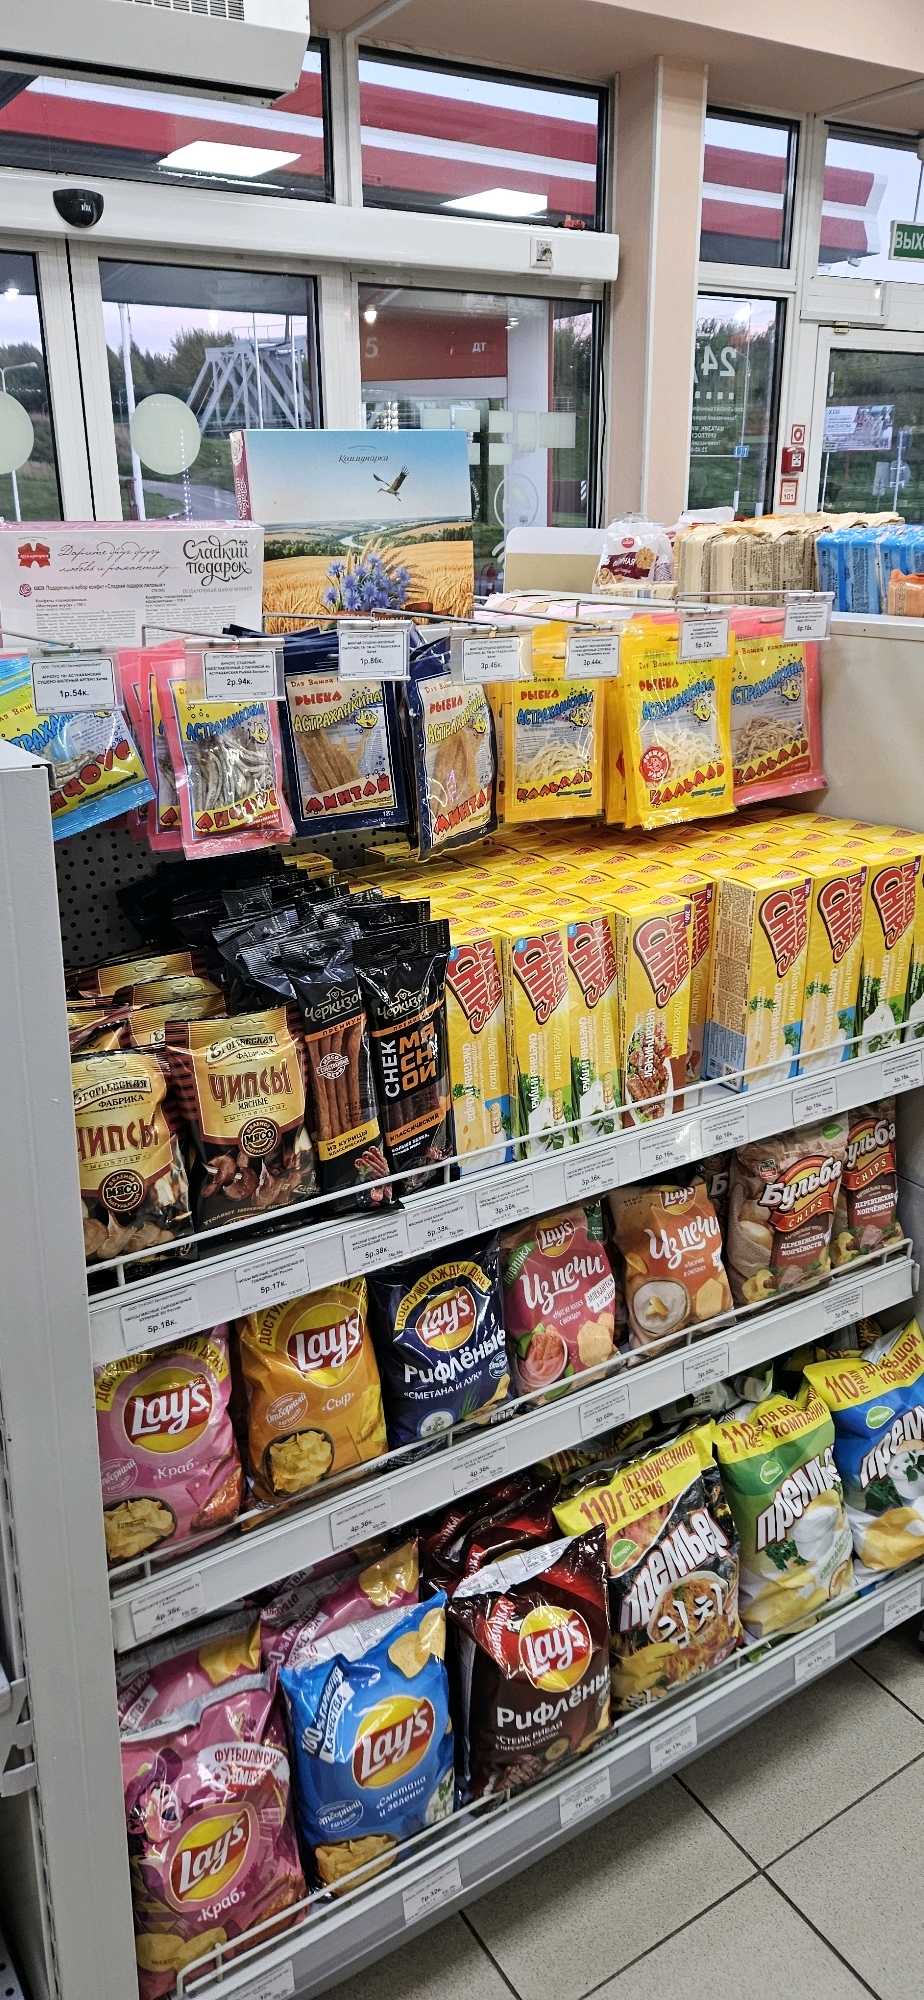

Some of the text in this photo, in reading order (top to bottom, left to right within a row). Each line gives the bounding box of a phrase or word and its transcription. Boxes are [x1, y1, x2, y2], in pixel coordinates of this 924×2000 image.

[894, 231, 924, 250] ВЫХ
[365, 337, 379, 358] 5
[472, 341, 487, 353] ДТ
[183, 535, 250, 561] Сладкий
[186, 561, 252, 587] подарок
[59, 689, 90, 699] 1р.54к.
[226, 678, 253, 687] 2р.94к.
[290, 679, 305, 688] Для
[520, 689, 560, 701] РЫБКА
[638, 677, 680, 692] РЫБКА
[293, 691, 382, 733] АСТРАХАНКИНА
[295, 690, 342, 707] РЫБКА
[429, 695, 464, 714] РЫБКА
[305, 773, 391, 815] МИНТАЙ
[516, 770, 593, 801] КАЛЬМАР
[649, 763, 726, 806] КАЛЬМАР
[821, 878, 852, 962] CHIPS
[874, 867, 906, 949] CHIPS
[762, 890, 798, 978] CHIPS
[637, 917, 677, 1008] CHIPS
[771, 982, 782, 1030] сметаны
[788, 967, 800, 1021] Мега Чипсы
[826, 968, 838, 1015] сметаны
[399, 1021, 435, 1054] МЯ
[579, 1017, 588, 1060] сметаны
[601, 1012, 612, 1064] Мега Чипсы
[643, 1008, 656, 1077] чевапчичей
[671, 1001, 683, 1059] Мега Чипсы
[381, 1040, 400, 1097] СНЕК
[463, 1043, 473, 1085] сметаны
[487, 1037, 499, 1090] Мега Чипсы
[529, 1034, 539, 1076] сметаны
[552, 1028, 562, 1080] Мега Чипсы
[208, 1061, 292, 1108] ЧИПСЫ
[402, 1060, 436, 1091] ОЙ
[579, 1068, 591, 1092] лука
[98, 1094, 145, 1108] ФАБРИКА
[238, 1098, 269, 1111] МЯСНЫЕ
[464, 1096, 476, 1122] сыра
[528, 1085, 541, 1109] лука
[244, 1129, 275, 1146] МЯСО
[327, 1130, 368, 1152] ИЗ КУРИЦЫ
[390, 1112, 440, 1141] КЛАССИЧЕСКИЙ
[107, 1174, 136, 1189] ВЯЛЕНОЕ
[758, 1156, 843, 1212] Бульба
[855, 1157, 887, 1185] CHIPS
[106, 1183, 139, 1200] МЯСО
[854, 1192, 894, 1209] ДЕРЕВЕНСКИЕ
[788, 1198, 824, 1228] CHIPS
[426, 1224, 451, 1237] 5р.38к.
[538, 1221, 573, 1250] Lay's
[644, 1216, 721, 1270] Из печи
[780, 1232, 824, 1250] ДЕРЕВЕНСКИЕ
[364, 1246, 390, 1258] 5р.38к.
[781, 1241, 822, 1256] КОПЧЁНОСТИ
[503, 1244, 532, 1285] НОВИНКА
[260, 1280, 288, 1294] 5р.17к.
[520, 1254, 605, 1316] Из печи
[396, 1280, 429, 1327] ДОСТУПНО
[421, 1289, 470, 1341] Lay's
[147, 1319, 178, 1334] 5р.18к.
[295, 1316, 360, 1372] Lay's
[404, 1329, 506, 1384] Рифлёные
[403, 1369, 483, 1400] «СМЕТАНА И ЛУК»
[824, 1373, 860, 1404] 110
[131, 1382, 208, 1436] Lay's
[266, 1392, 307, 1423] Отборный
[322, 1390, 356, 1412] «Сыр»
[771, 1402, 827, 1439] КОМПАНИИ
[152, 1457, 200, 1481] «Краб»
[622, 1439, 696, 1495] ОГРАНИЧЕННАЯ
[579, 1489, 627, 1530] 110г
[629, 1479, 667, 1512] СЕРИЯ
[350, 1518, 374, 1534] 4р.36к.
[155, 1606, 183, 1622] 4р.36к.
[657, 1583, 723, 1649] 김치
[526, 1618, 588, 1679] Lay's
[323, 1692, 347, 1754] КАЧЕСТВА
[497, 1732, 533, 1745] «СТЕЙК
[361, 1705, 429, 1783] Lay's
[376, 1774, 427, 1809] «Сметана
[379, 1786, 425, 1817] и зелень»
[179, 1816, 245, 1894] Lay's
[197, 1886, 247, 1924] «Краб»
